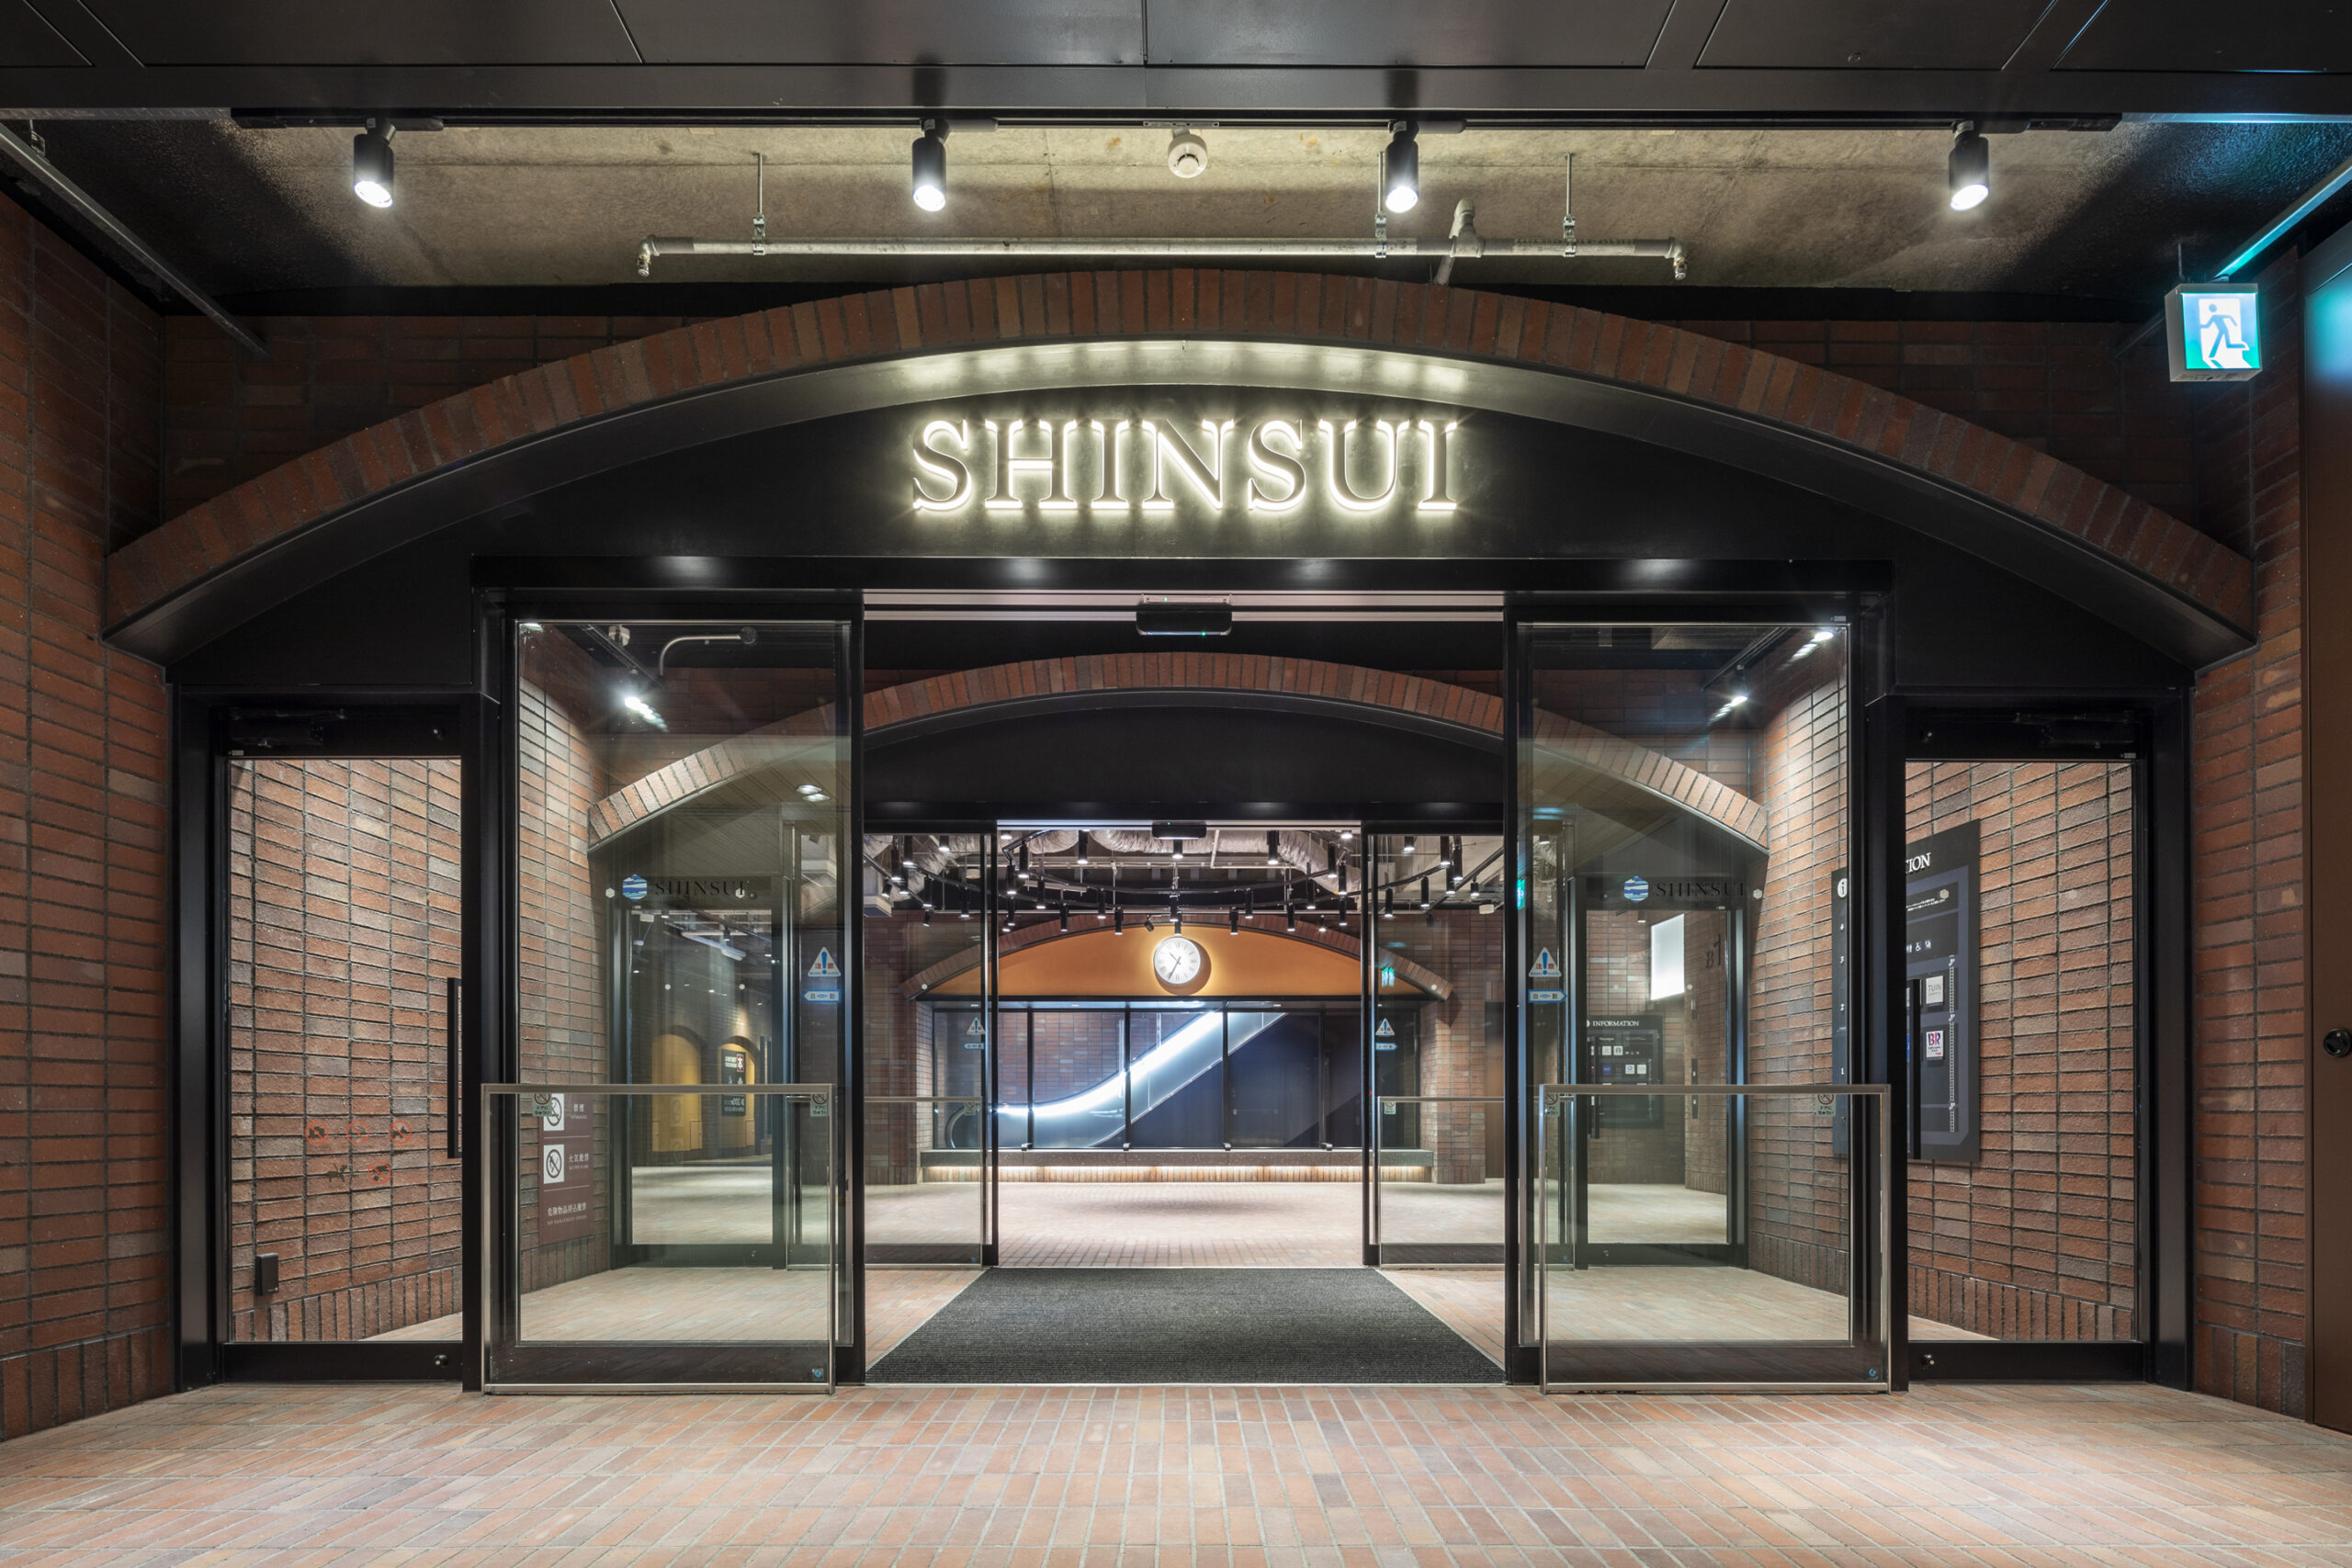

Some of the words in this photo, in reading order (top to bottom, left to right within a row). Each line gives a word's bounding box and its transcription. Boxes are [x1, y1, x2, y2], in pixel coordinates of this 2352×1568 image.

[911, 417, 1459, 512] SHINSUI
[654, 879, 746, 897] SHINSUI
[1656, 881, 1745, 897] SHINSUI
